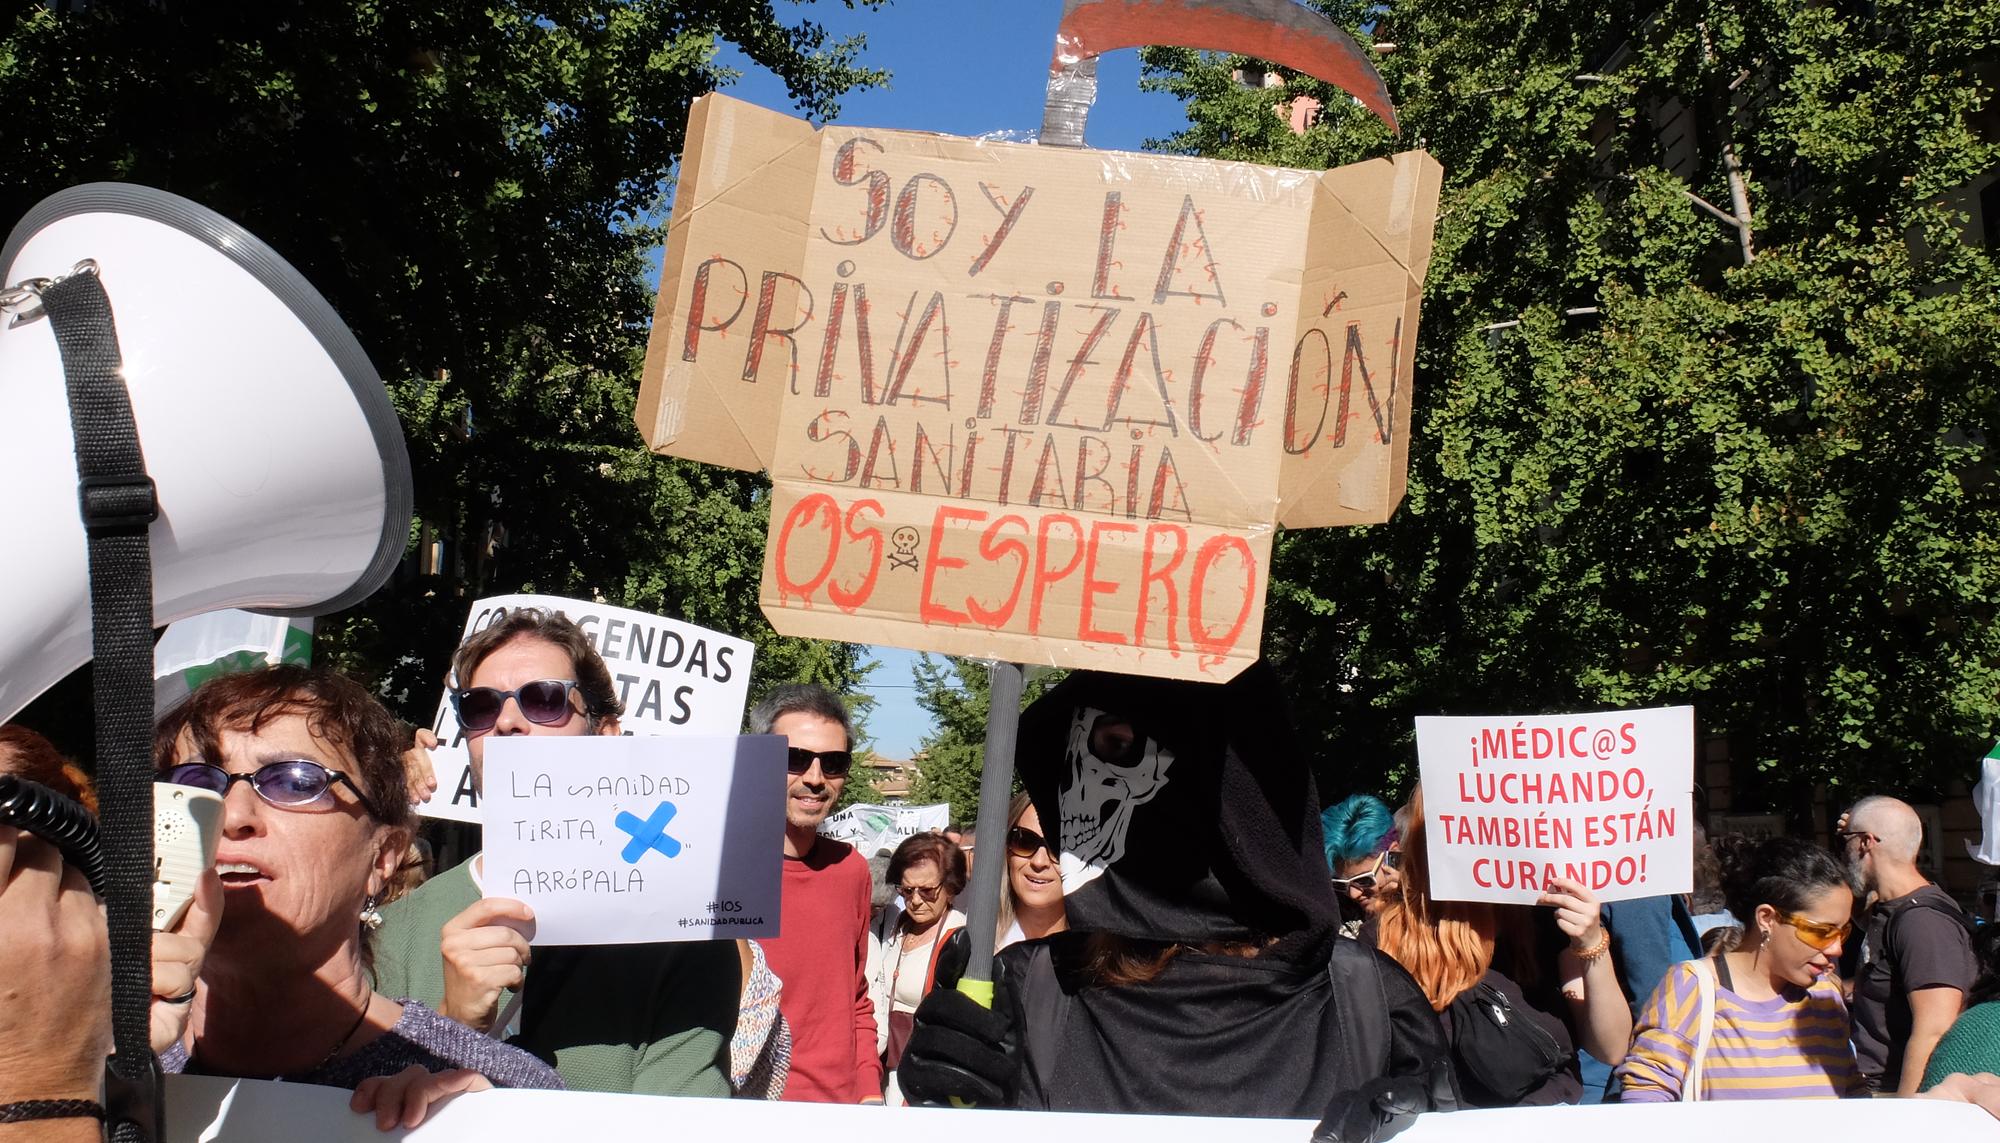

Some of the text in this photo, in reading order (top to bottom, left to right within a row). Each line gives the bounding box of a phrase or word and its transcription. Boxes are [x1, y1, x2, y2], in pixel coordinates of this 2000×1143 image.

[820, 137, 1225, 307] SOY LA
[775, 493, 1257, 662] OS ESPERO
[557, 610, 734, 683] GENDAS
[1471, 722, 1636, 767] ¡MÉDIC@S
[511, 771, 552, 798] LA
[1459, 768, 1653, 804] LUCHANDO,
[832, 811, 854, 823] UNA
[1440, 804, 1676, 848] TAMBIÉN ESTÁN
[1472, 854, 1647, 891] CURANDO!
